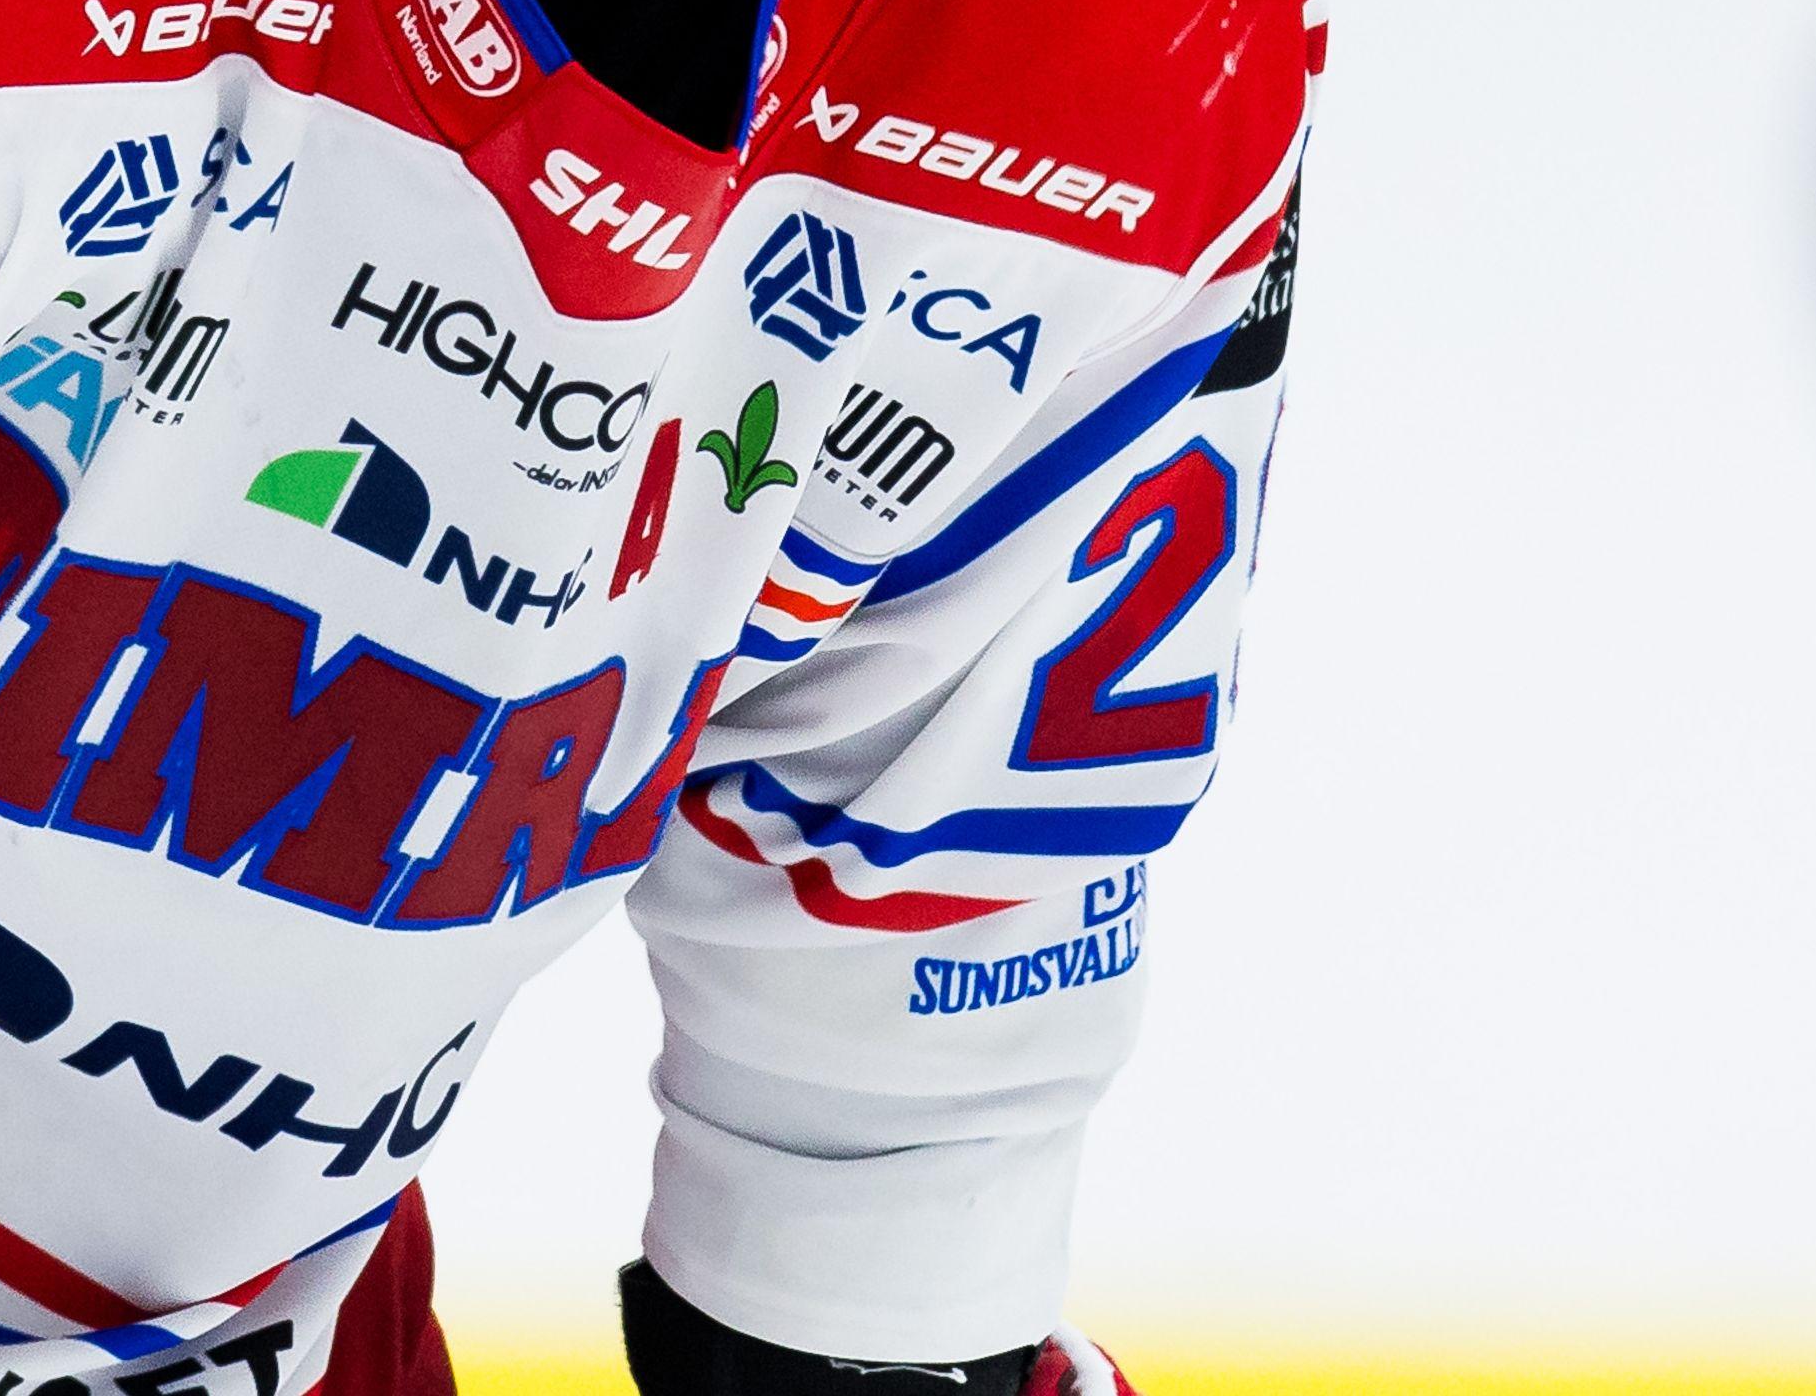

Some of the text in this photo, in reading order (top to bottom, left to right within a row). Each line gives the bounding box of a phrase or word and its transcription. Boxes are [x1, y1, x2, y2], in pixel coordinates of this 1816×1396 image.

[528, 148, 693, 270] SHL
[854, 115, 1156, 233] BAUER
[60, 1020, 478, 1178] NHC
